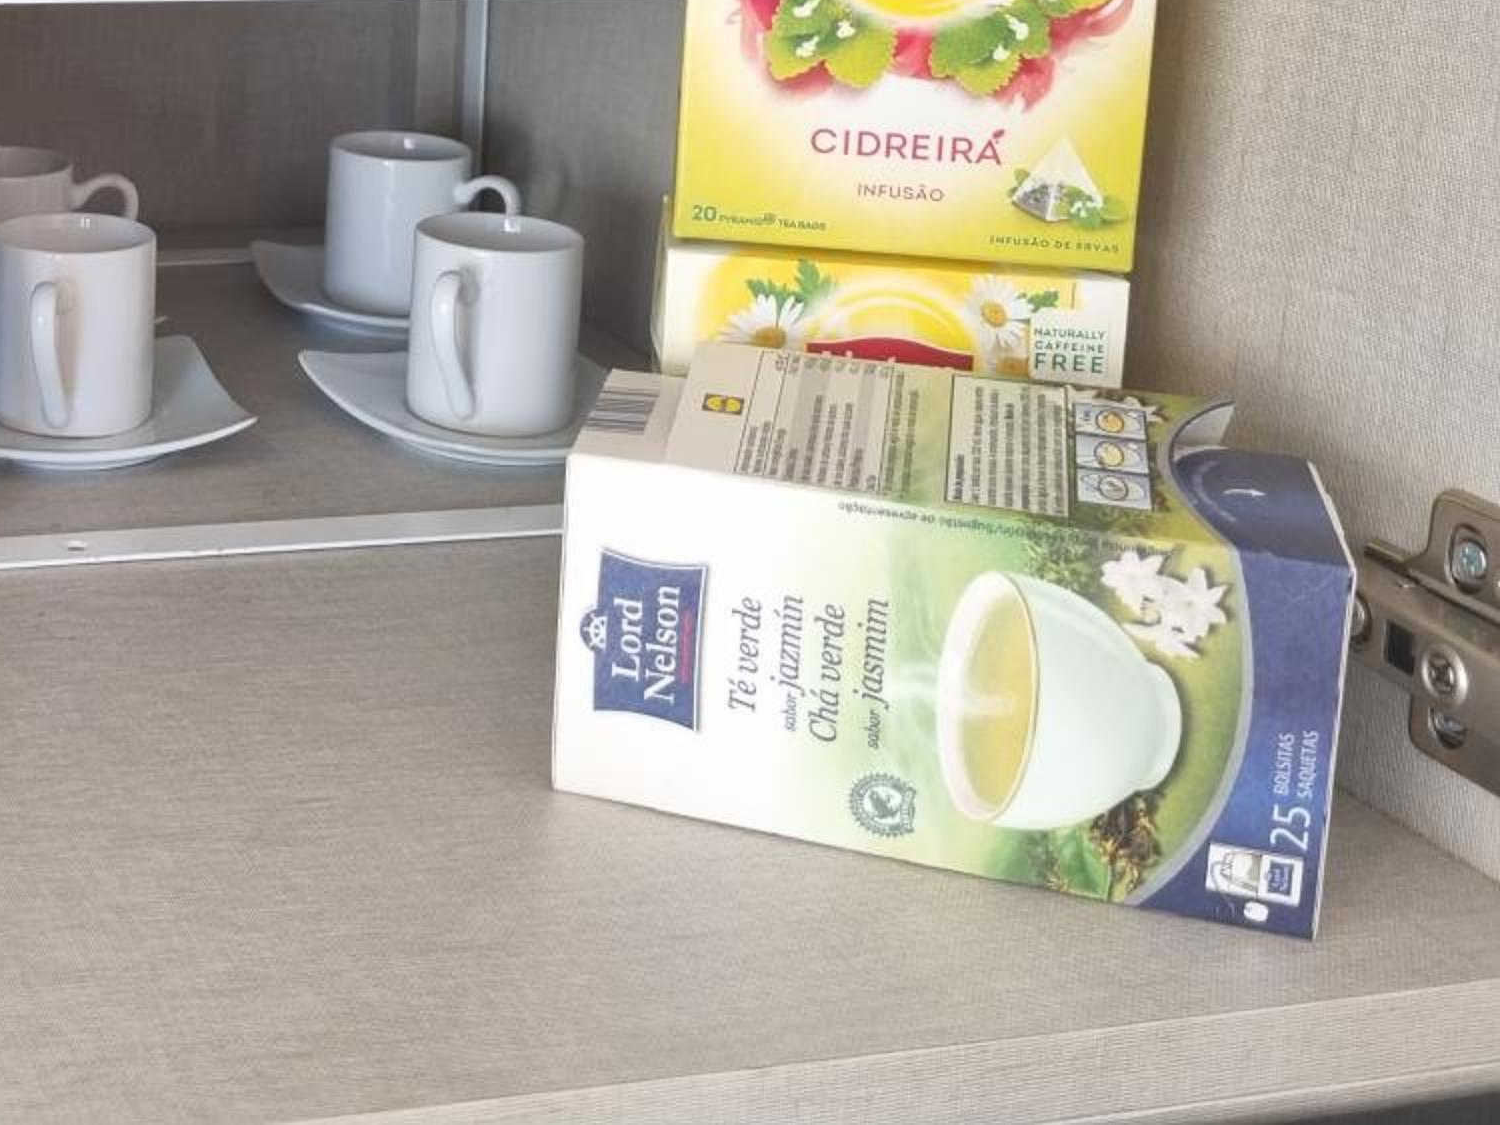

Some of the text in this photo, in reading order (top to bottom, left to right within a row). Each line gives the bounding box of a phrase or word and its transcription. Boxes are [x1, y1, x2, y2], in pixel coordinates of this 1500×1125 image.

[691, 204, 717, 222] 20
[857, 181, 945, 202] INFUSÃO
[989, 234, 1049, 249] INFUSÃO
[1054, 239, 1072, 250] DE
[1034, 327, 1106, 340] NATURALLY
[1034, 352, 1104, 374] FREE
[1035, 340, 1105, 354] CAFFEINE
[611, 597, 643, 682] Lord
[643, 586, 681, 706] Nelson
[727, 596, 762, 713] Té verde
[769, 595, 805, 732] sabor jazmín
[807, 603, 846, 743] Chá verde
[852, 598, 890, 750] sabor jasmim
[1272, 733, 1296, 797] BOLSITAS
[1296, 730, 1320, 800] SAQUETAS
[1269, 803, 1311, 852] 25
